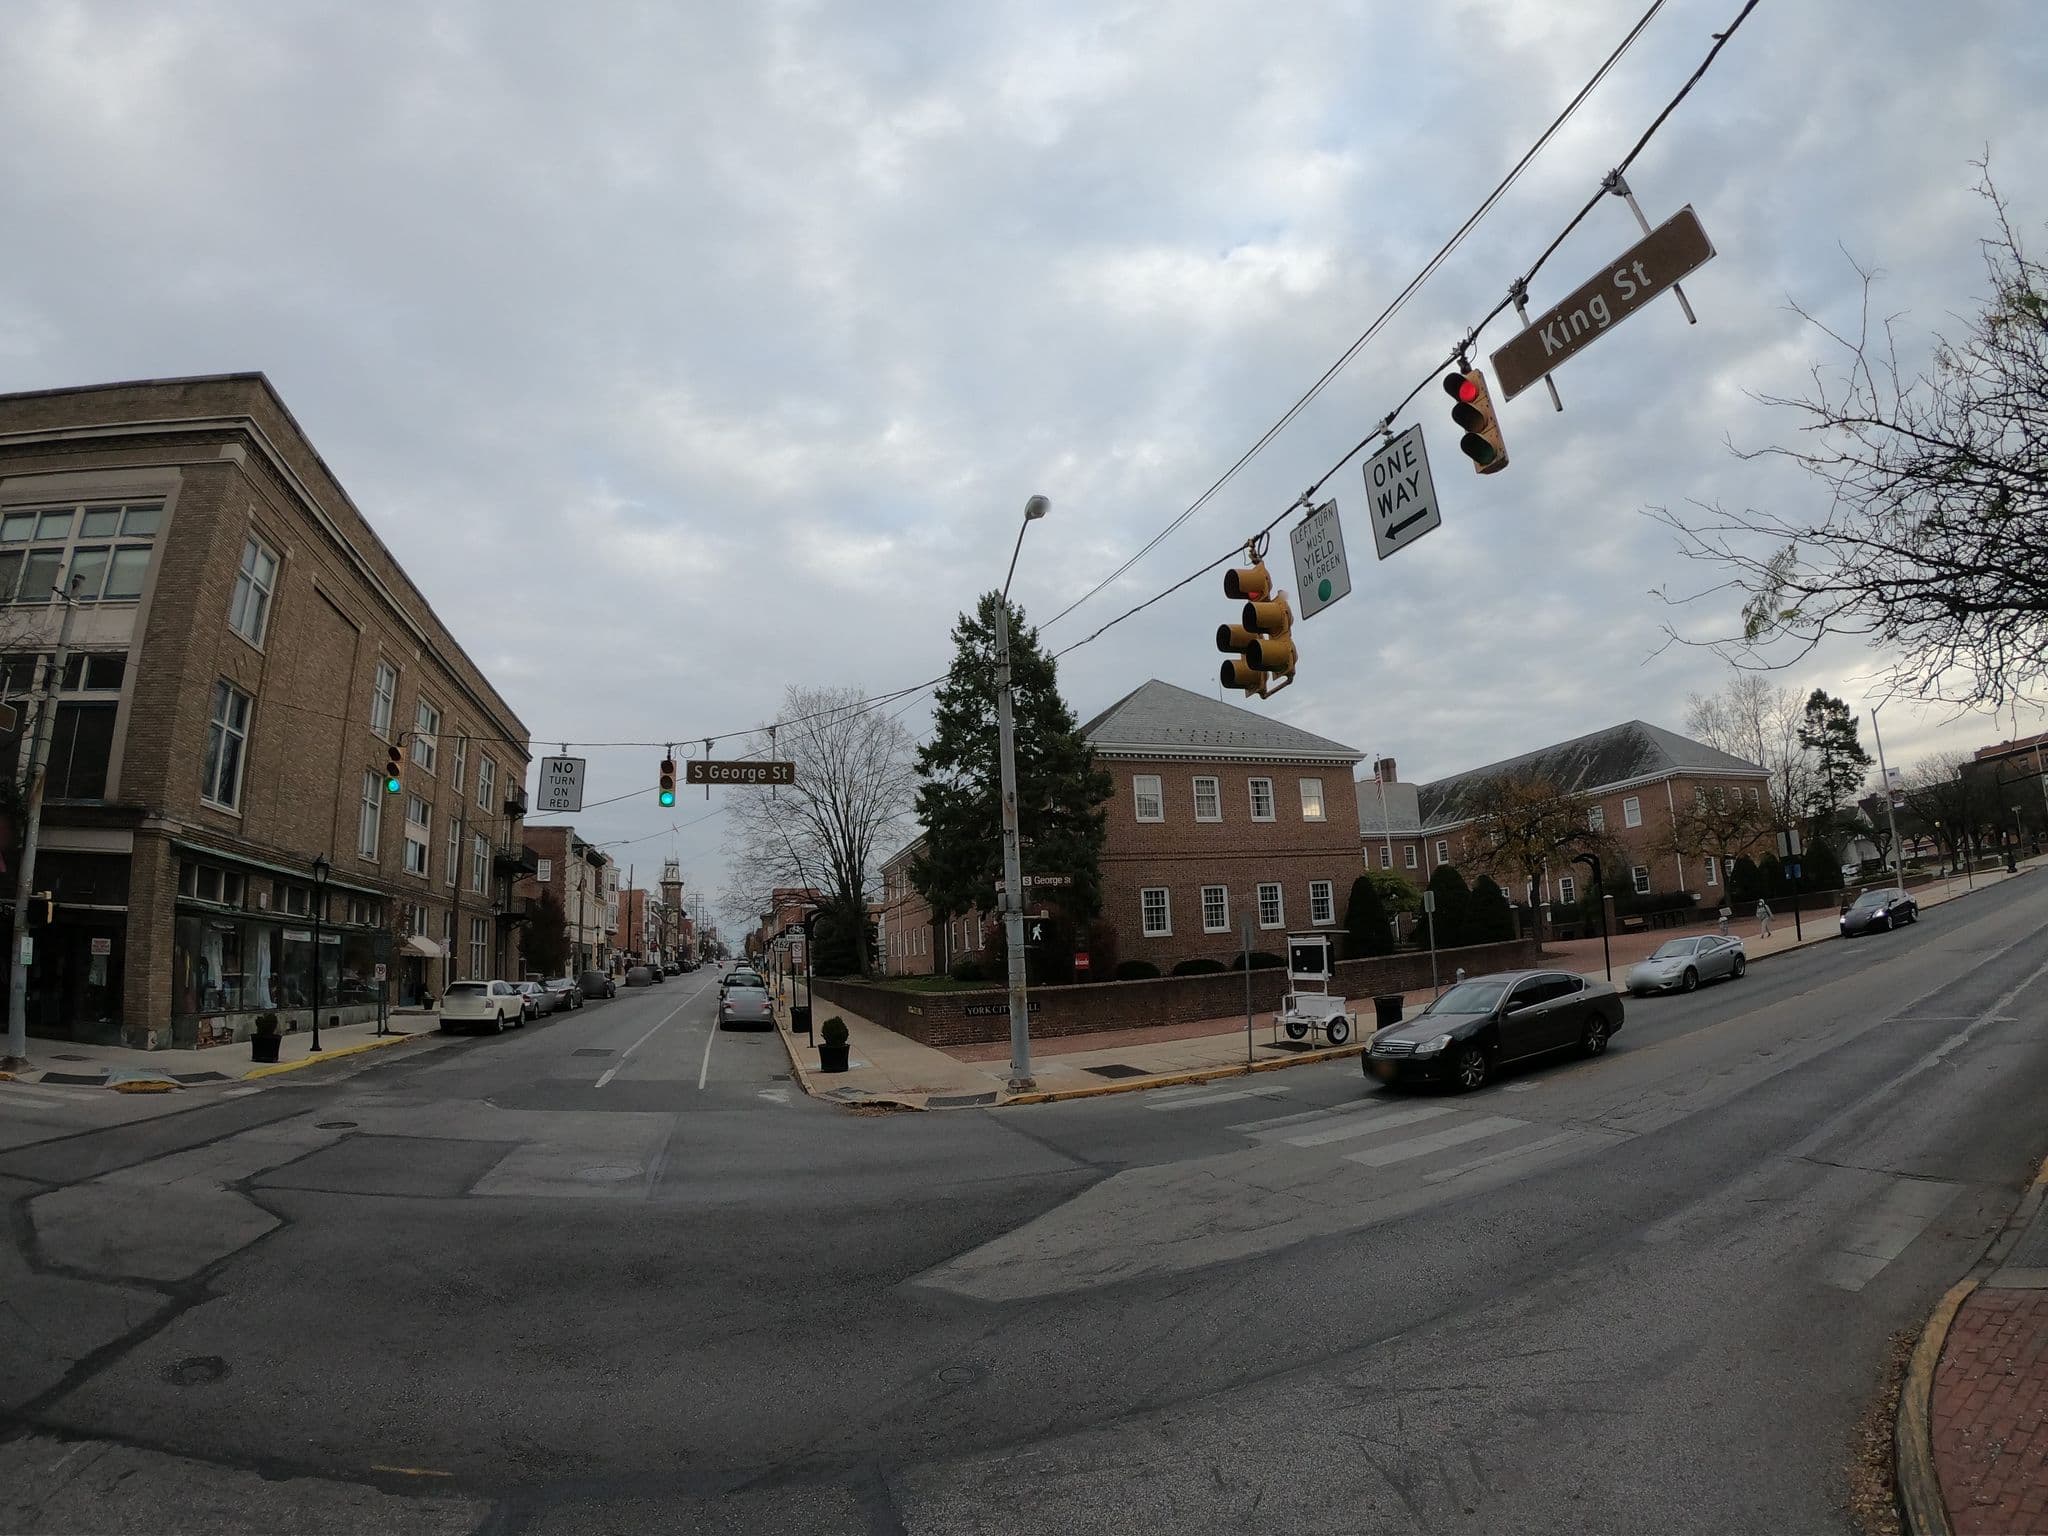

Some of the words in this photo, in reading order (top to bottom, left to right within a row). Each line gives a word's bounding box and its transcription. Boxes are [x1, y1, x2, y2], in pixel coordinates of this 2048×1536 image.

[1538, 293, 1611, 356] King
[1613, 259, 1652, 301] St
[1373, 440, 1417, 487] ONE
[1377, 469, 1420, 519] WAY
[1294, 524, 1313, 544] LEFT
[1313, 506, 1335, 528] TURN
[1306, 528, 1327, 552] MUST
[1304, 540, 1334, 570] YIELD
[1303, 571, 1315, 587] ON
[1316, 553, 1342, 579] GREEN
[552, 761, 574, 774] NO
[694, 765, 703, 778] S
[709, 765, 767, 782] George
[772, 766, 788, 780] St
[549, 775, 576, 785] TURN
[553, 787, 569, 797] ON
[549, 798, 570, 808] RED
[1034, 876, 1062, 886] George
[1063, 876, 1071, 884] St
[774, 941, 790, 949] 462
[967, 1006, 992, 1015] YORK
